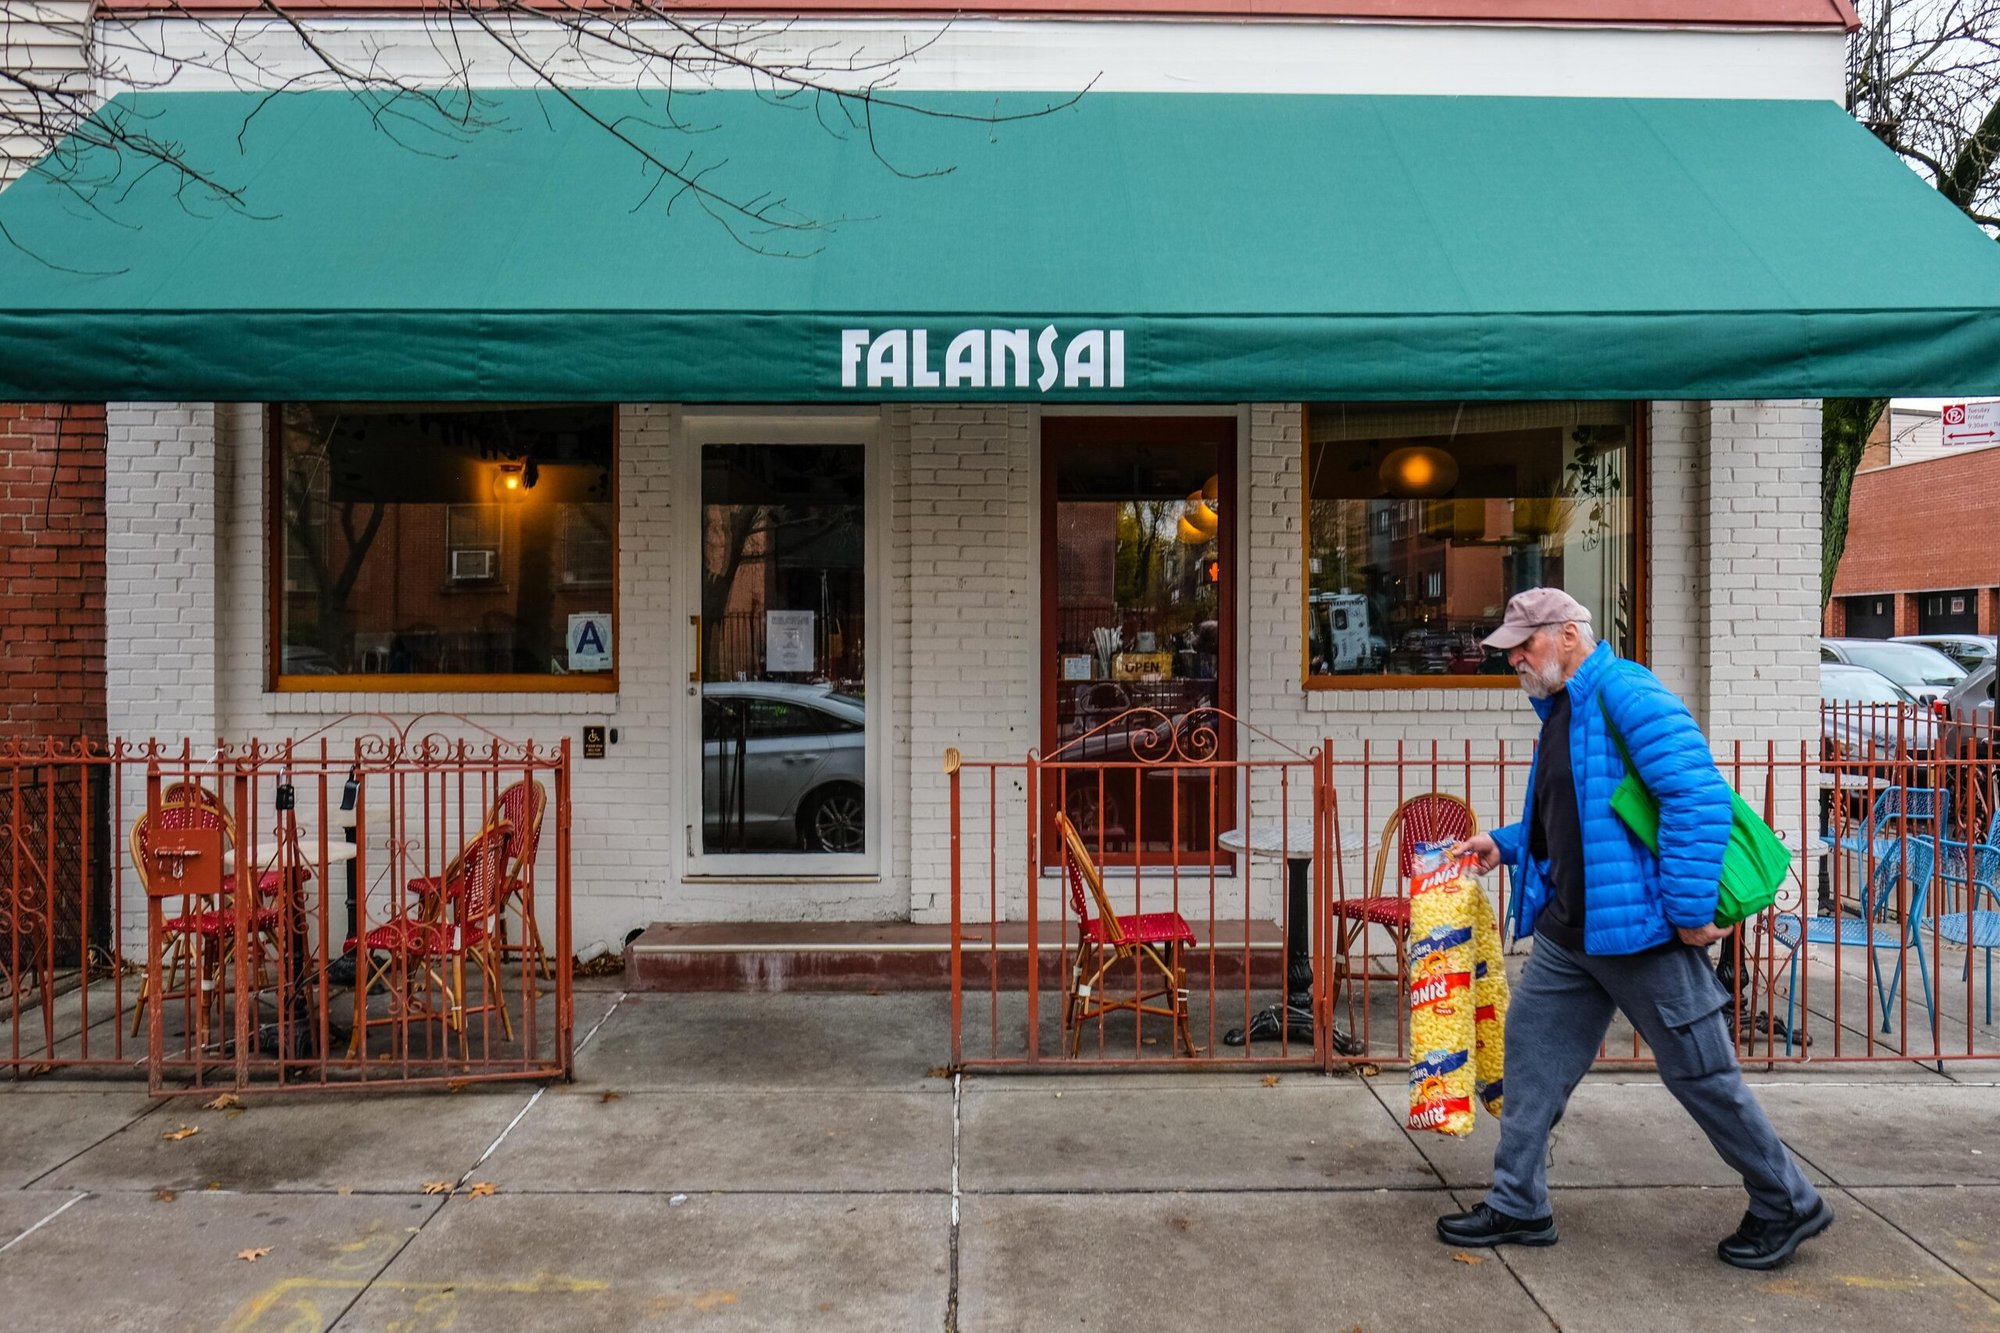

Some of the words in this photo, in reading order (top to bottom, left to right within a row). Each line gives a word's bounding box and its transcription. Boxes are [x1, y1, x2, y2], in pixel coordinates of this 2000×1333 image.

[842, 324, 1125, 392] FALANSAI
[575, 620, 605, 654] A
[1125, 661, 1160, 673] OPEN
